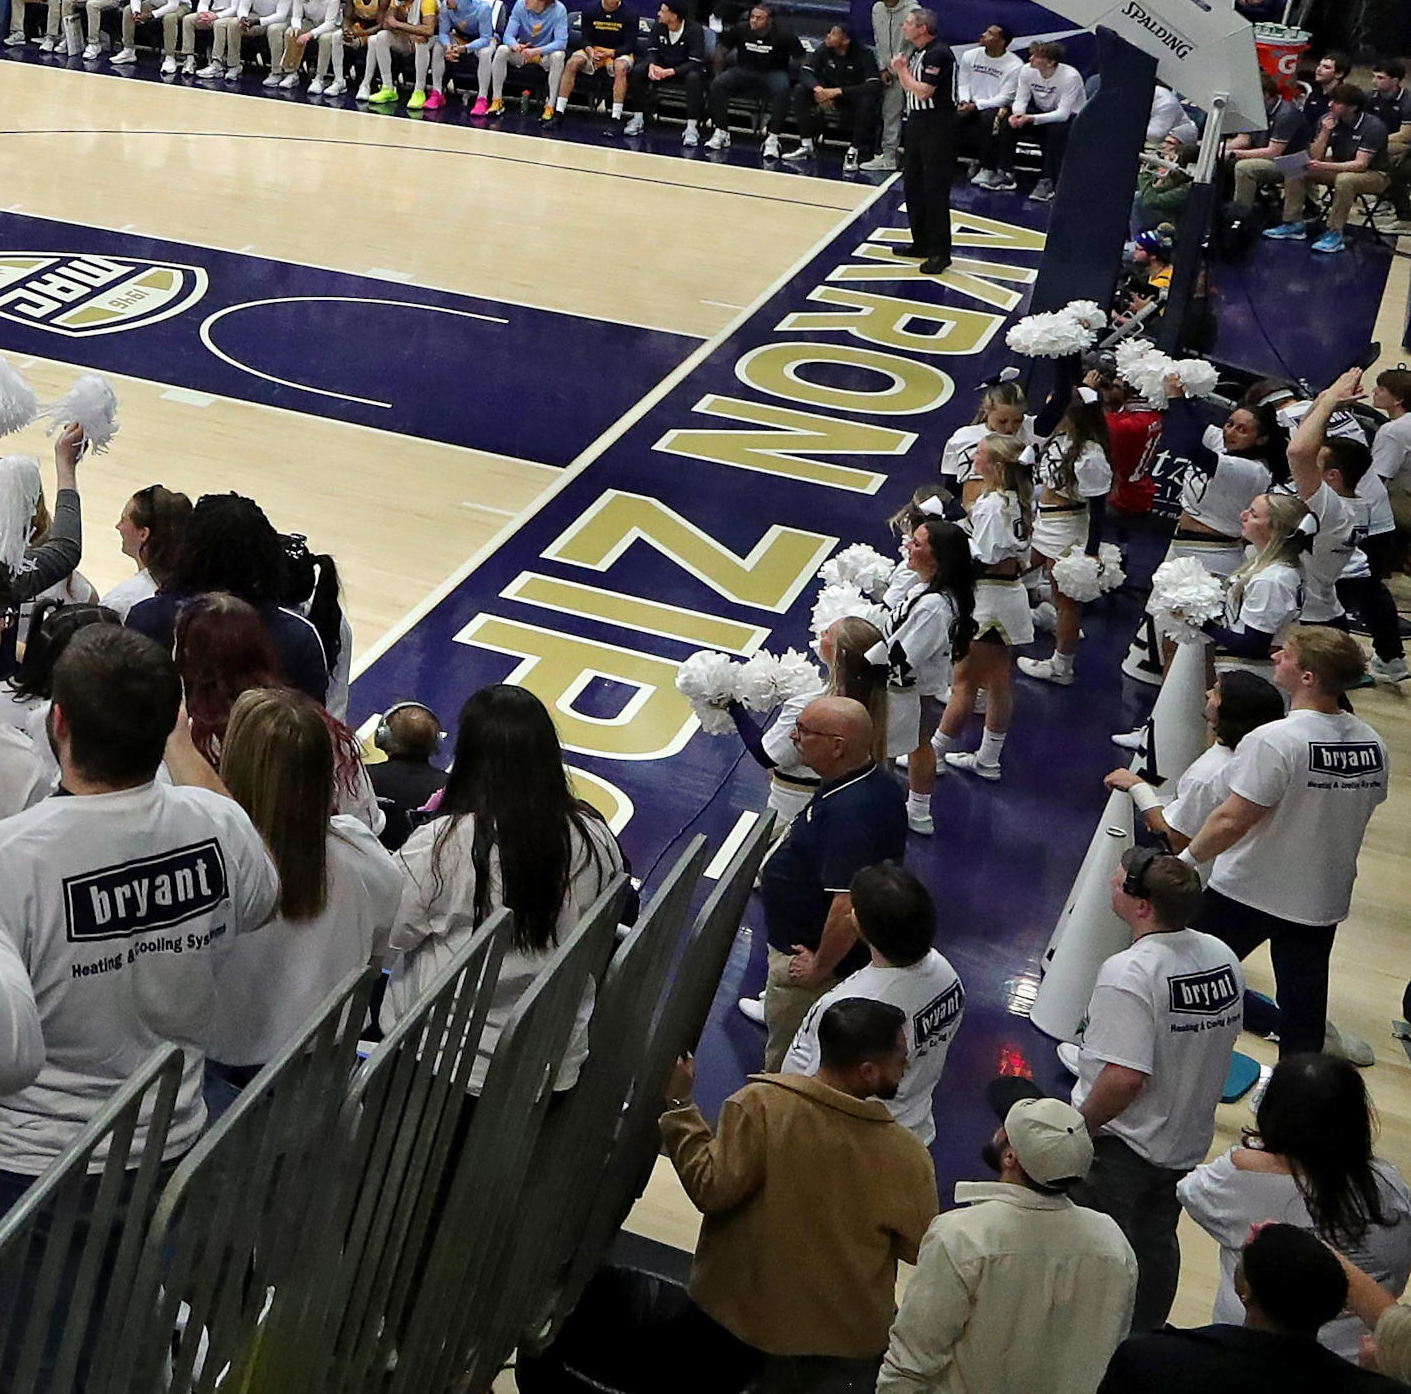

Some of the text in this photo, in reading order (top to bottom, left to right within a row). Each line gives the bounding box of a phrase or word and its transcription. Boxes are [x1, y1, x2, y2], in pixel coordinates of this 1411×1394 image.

[1121, 1, 1193, 59] SPALDING
[1279, 54, 1299, 74] G
[108, 288, 149, 311] 1946
[652, 208, 1047, 495] AKRON
[1321, 748, 1377, 769] bryant
[89, 857, 213, 927] bryant
[71, 946, 122, 979] Heating
[1180, 973, 1237, 1006] bryant
